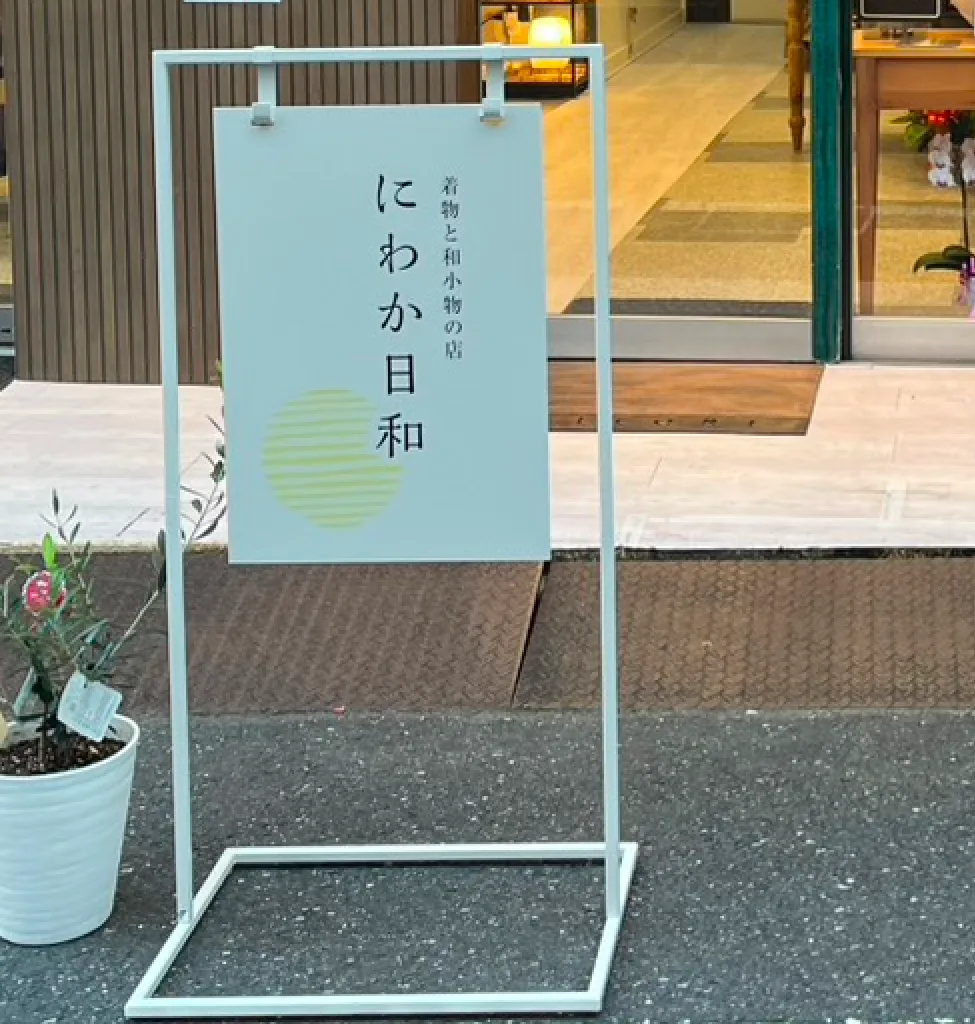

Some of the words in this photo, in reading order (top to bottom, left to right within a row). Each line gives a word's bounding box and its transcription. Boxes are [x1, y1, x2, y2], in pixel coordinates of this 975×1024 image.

[375, 173, 424, 459] にわか日和
[440, 175, 463, 361] 着物と和小物の店
